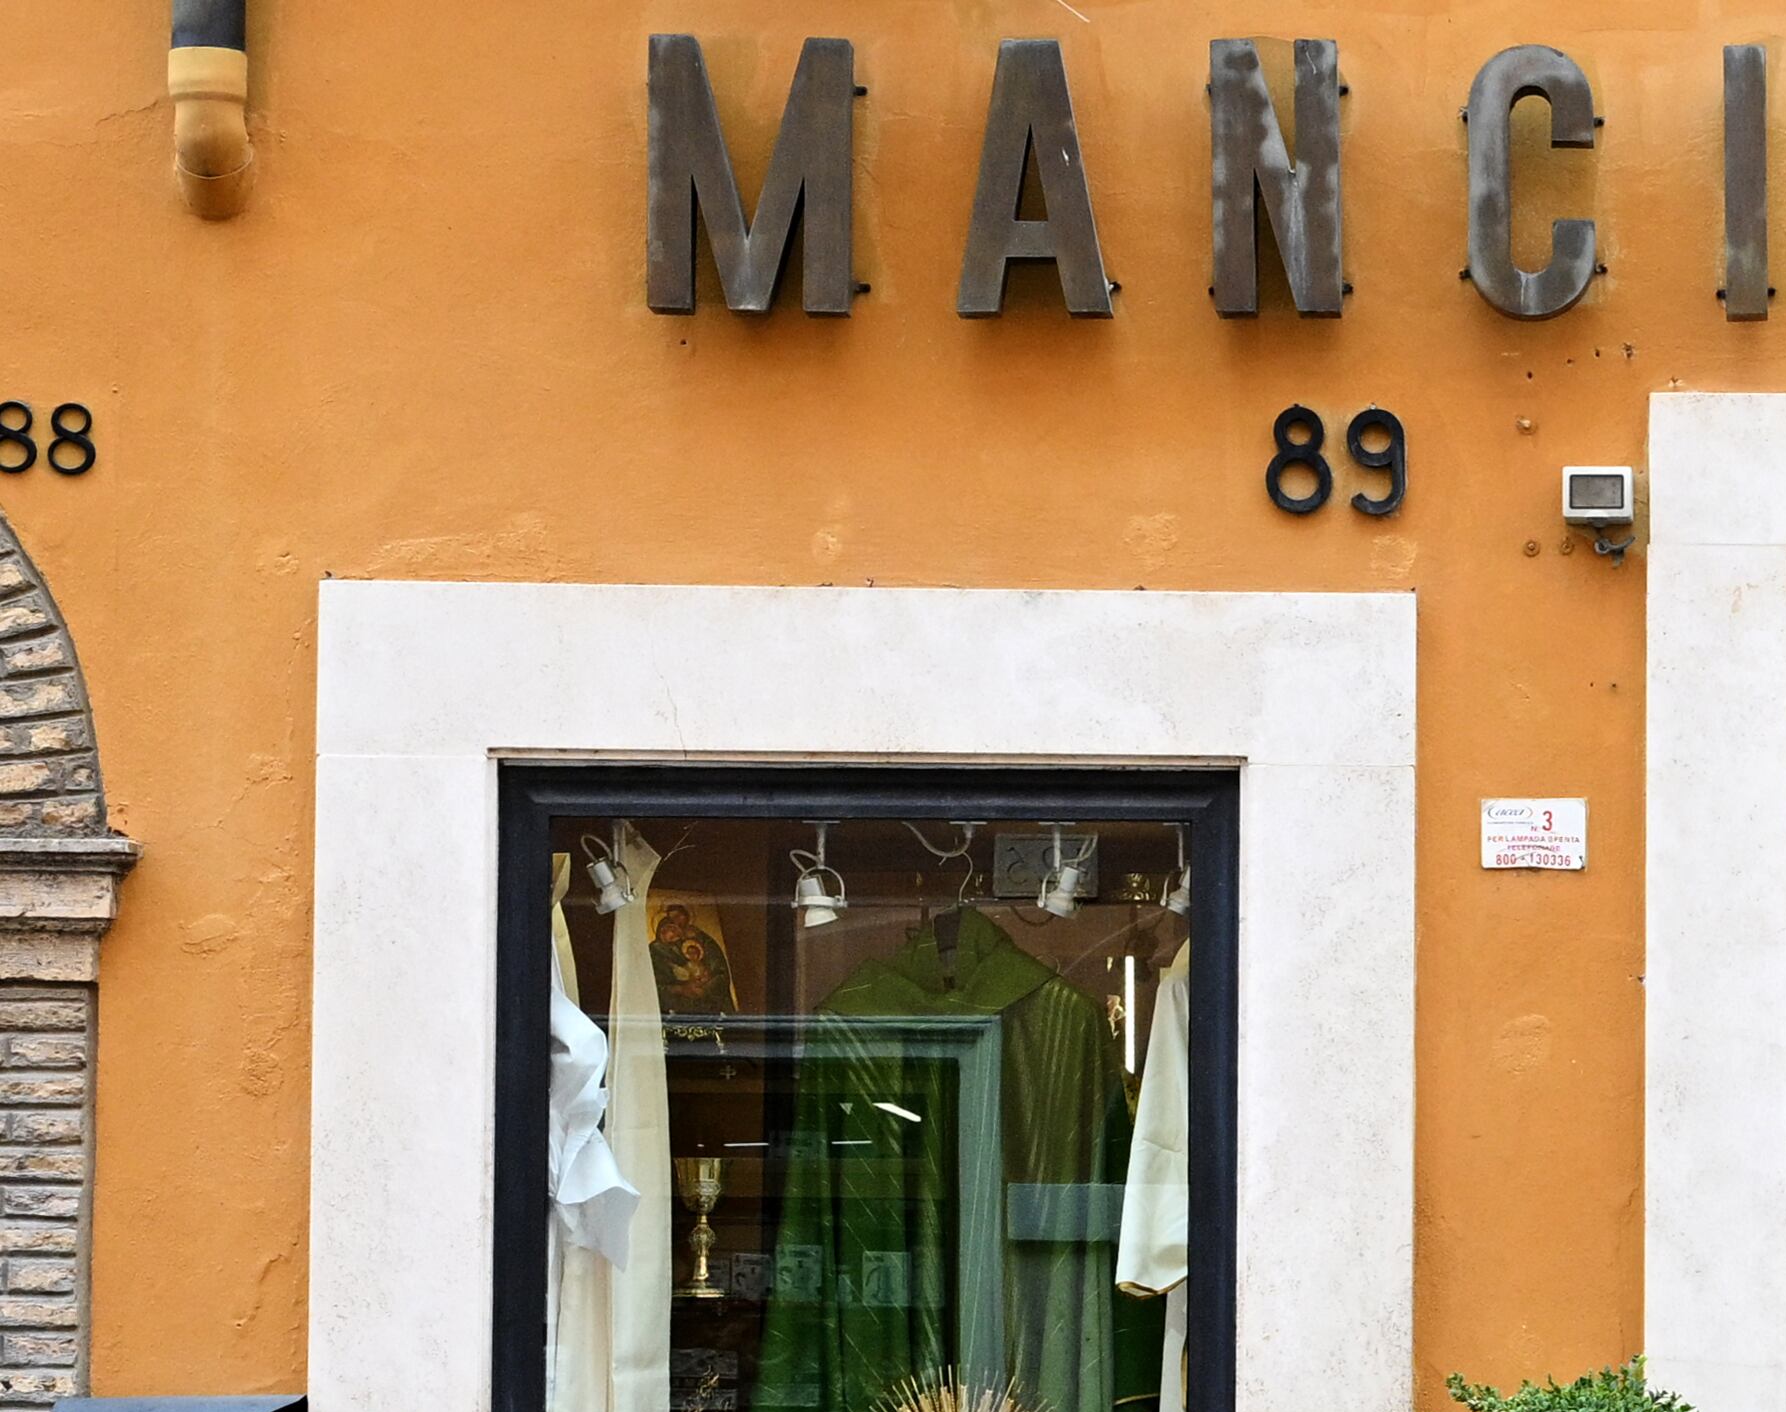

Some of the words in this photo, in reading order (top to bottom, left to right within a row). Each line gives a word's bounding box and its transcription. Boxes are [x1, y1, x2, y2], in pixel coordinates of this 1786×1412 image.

[0, 401, 96, 477] 88
[1265, 405, 1406, 516] 89
[1505, 834, 1546, 843] LAMPADA
[1542, 810, 1554, 832] 3
